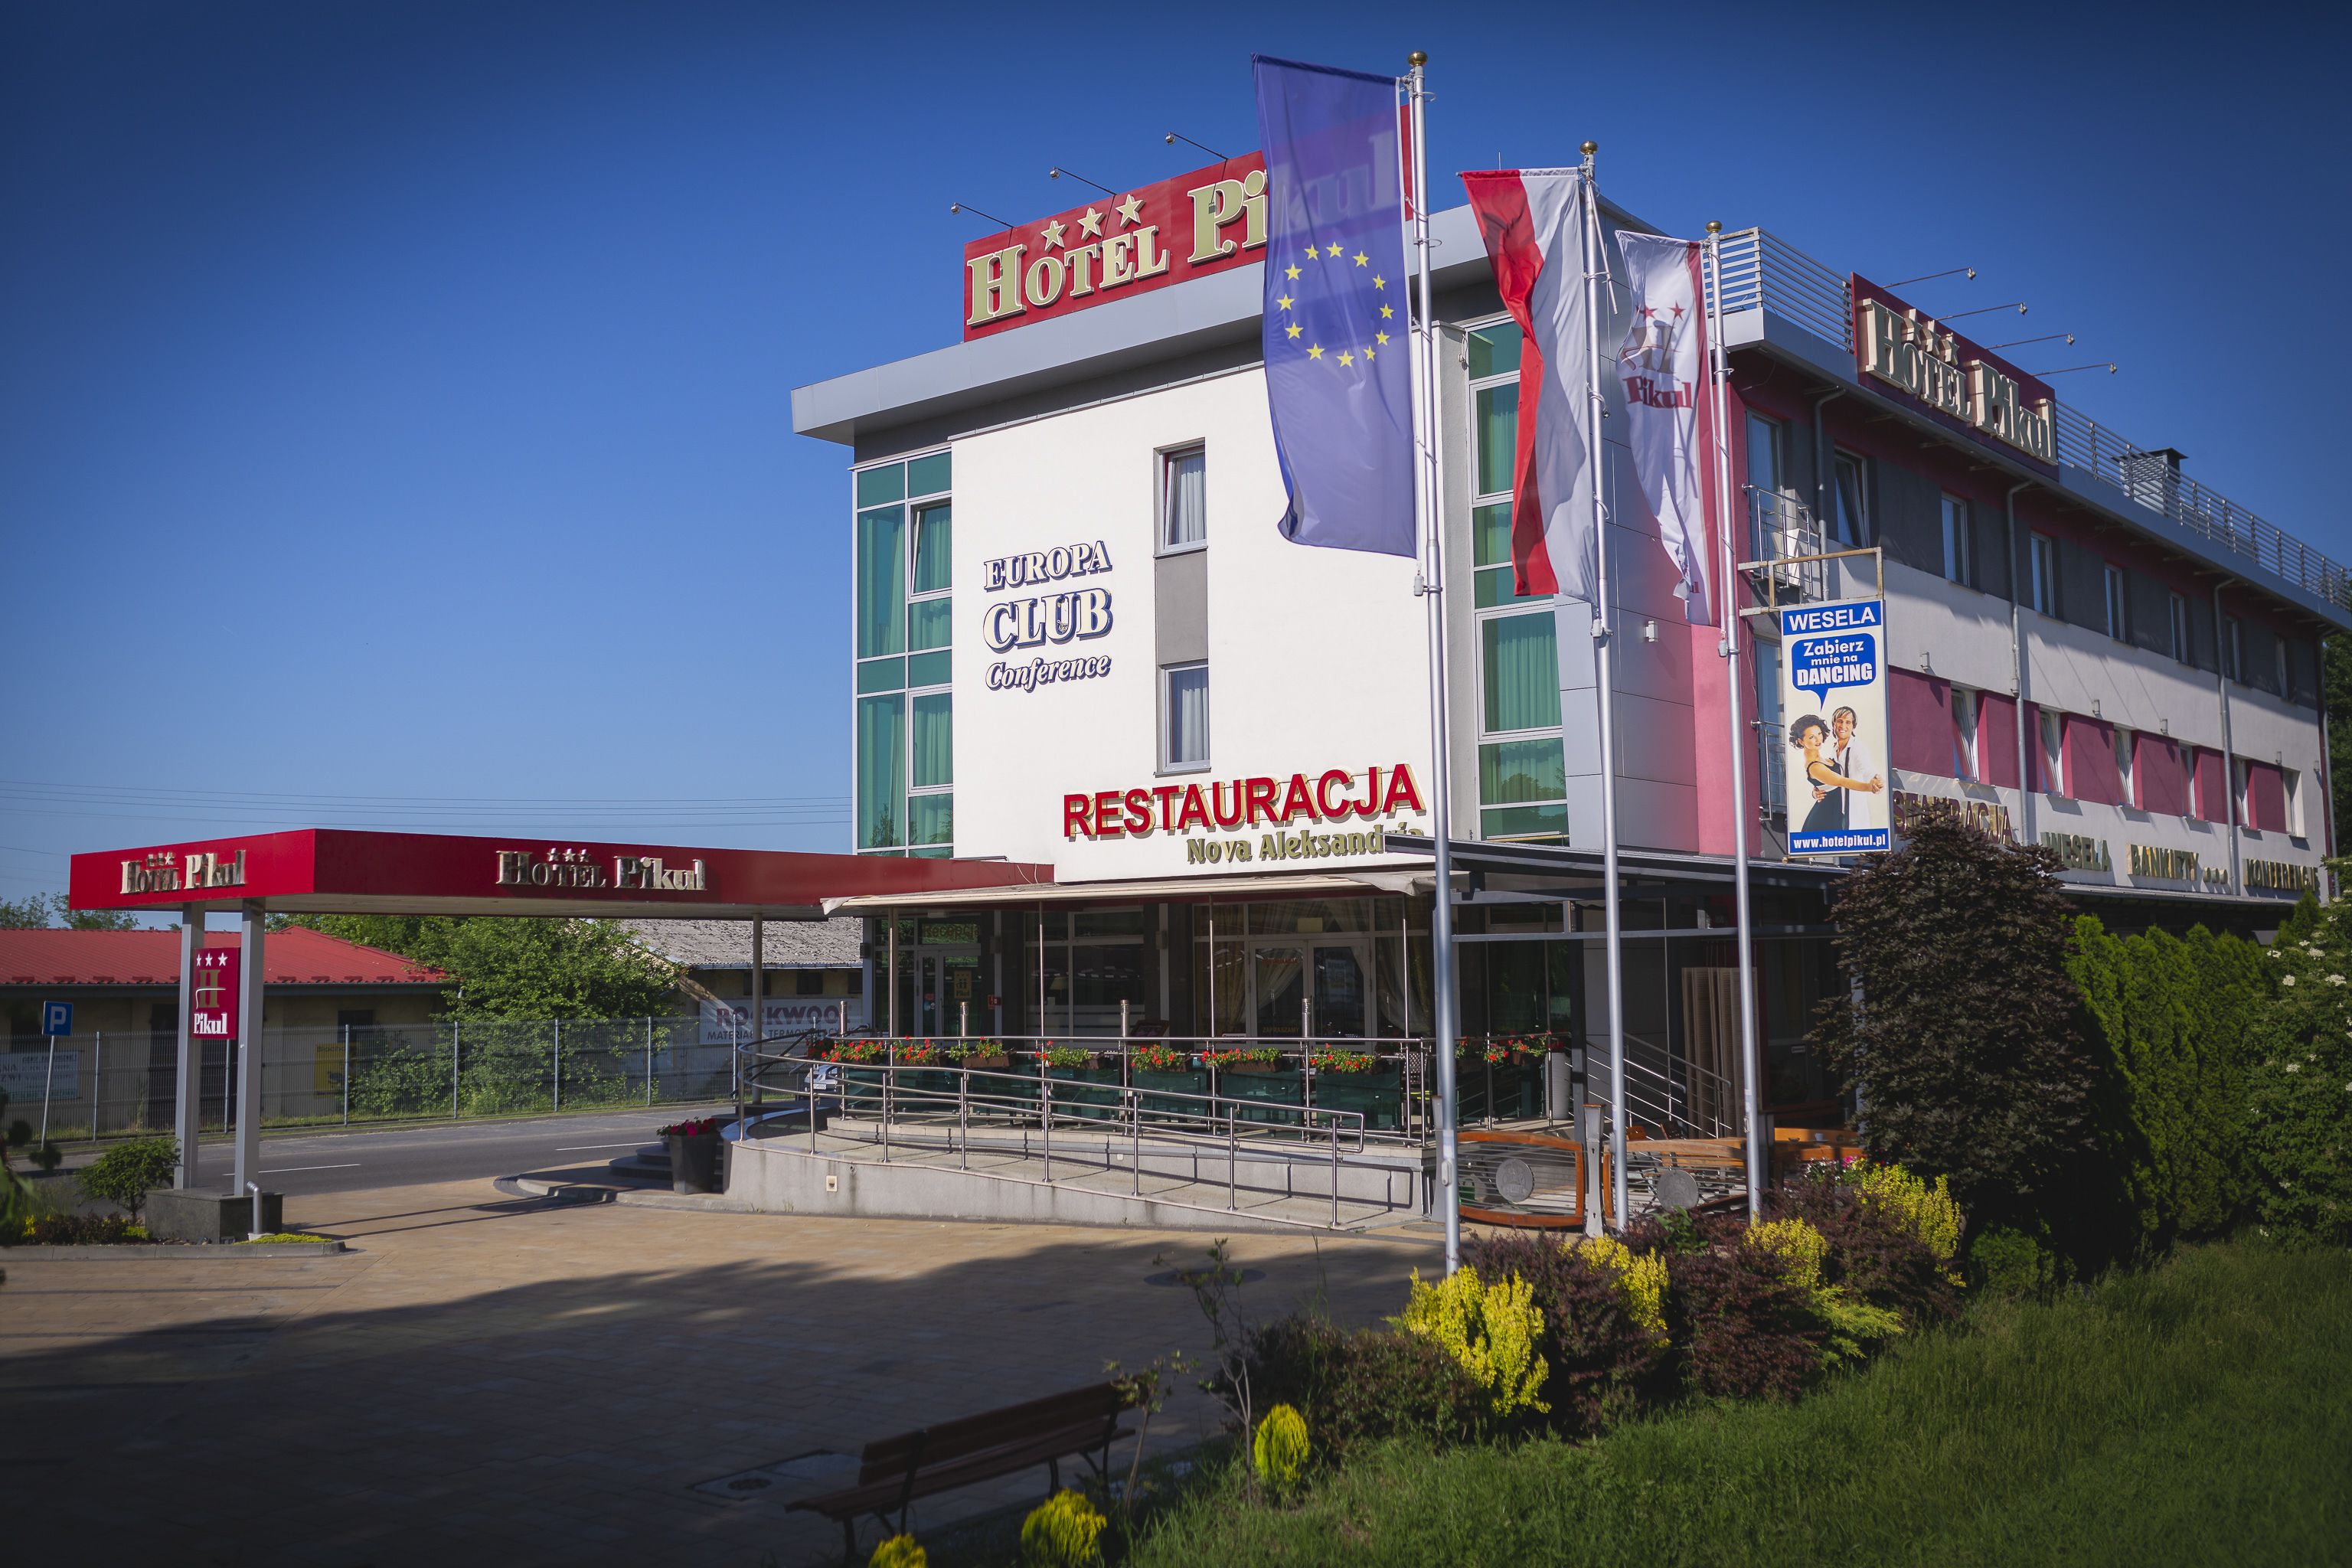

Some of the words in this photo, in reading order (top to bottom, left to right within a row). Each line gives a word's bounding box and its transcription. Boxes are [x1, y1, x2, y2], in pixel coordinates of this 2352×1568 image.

[966, 224, 1171, 325] HOTEL
[1863, 297, 1973, 422] HOTEL
[1622, 375, 1694, 410] Pikul
[983, 540, 1112, 593] EUROPA
[982, 587, 1113, 654] CLUB
[1788, 606, 1877, 632] WESELA
[1803, 639, 1865, 657] Zabierz
[1811, 655, 1841, 666] mnie
[1843, 655, 1858, 663] na
[985, 655, 1112, 692] Conference
[1796, 662, 1873, 687] DANCING
[1063, 763, 1427, 841] RESTAURACJA
[1187, 838, 1252, 865] Nova
[1259, 822, 1424, 861] Aleksand
[1793, 833, 1886, 849] www.hotelpikul.pl
[184, 850, 246, 890] Pikul
[496, 850, 606, 889] HOTEL
[613, 854, 708, 891] Pikul
[50, 1006, 67, 1031] P
[193, 1012, 227, 1034] Pikul
[716, 1004, 851, 1027] ROKWOO
